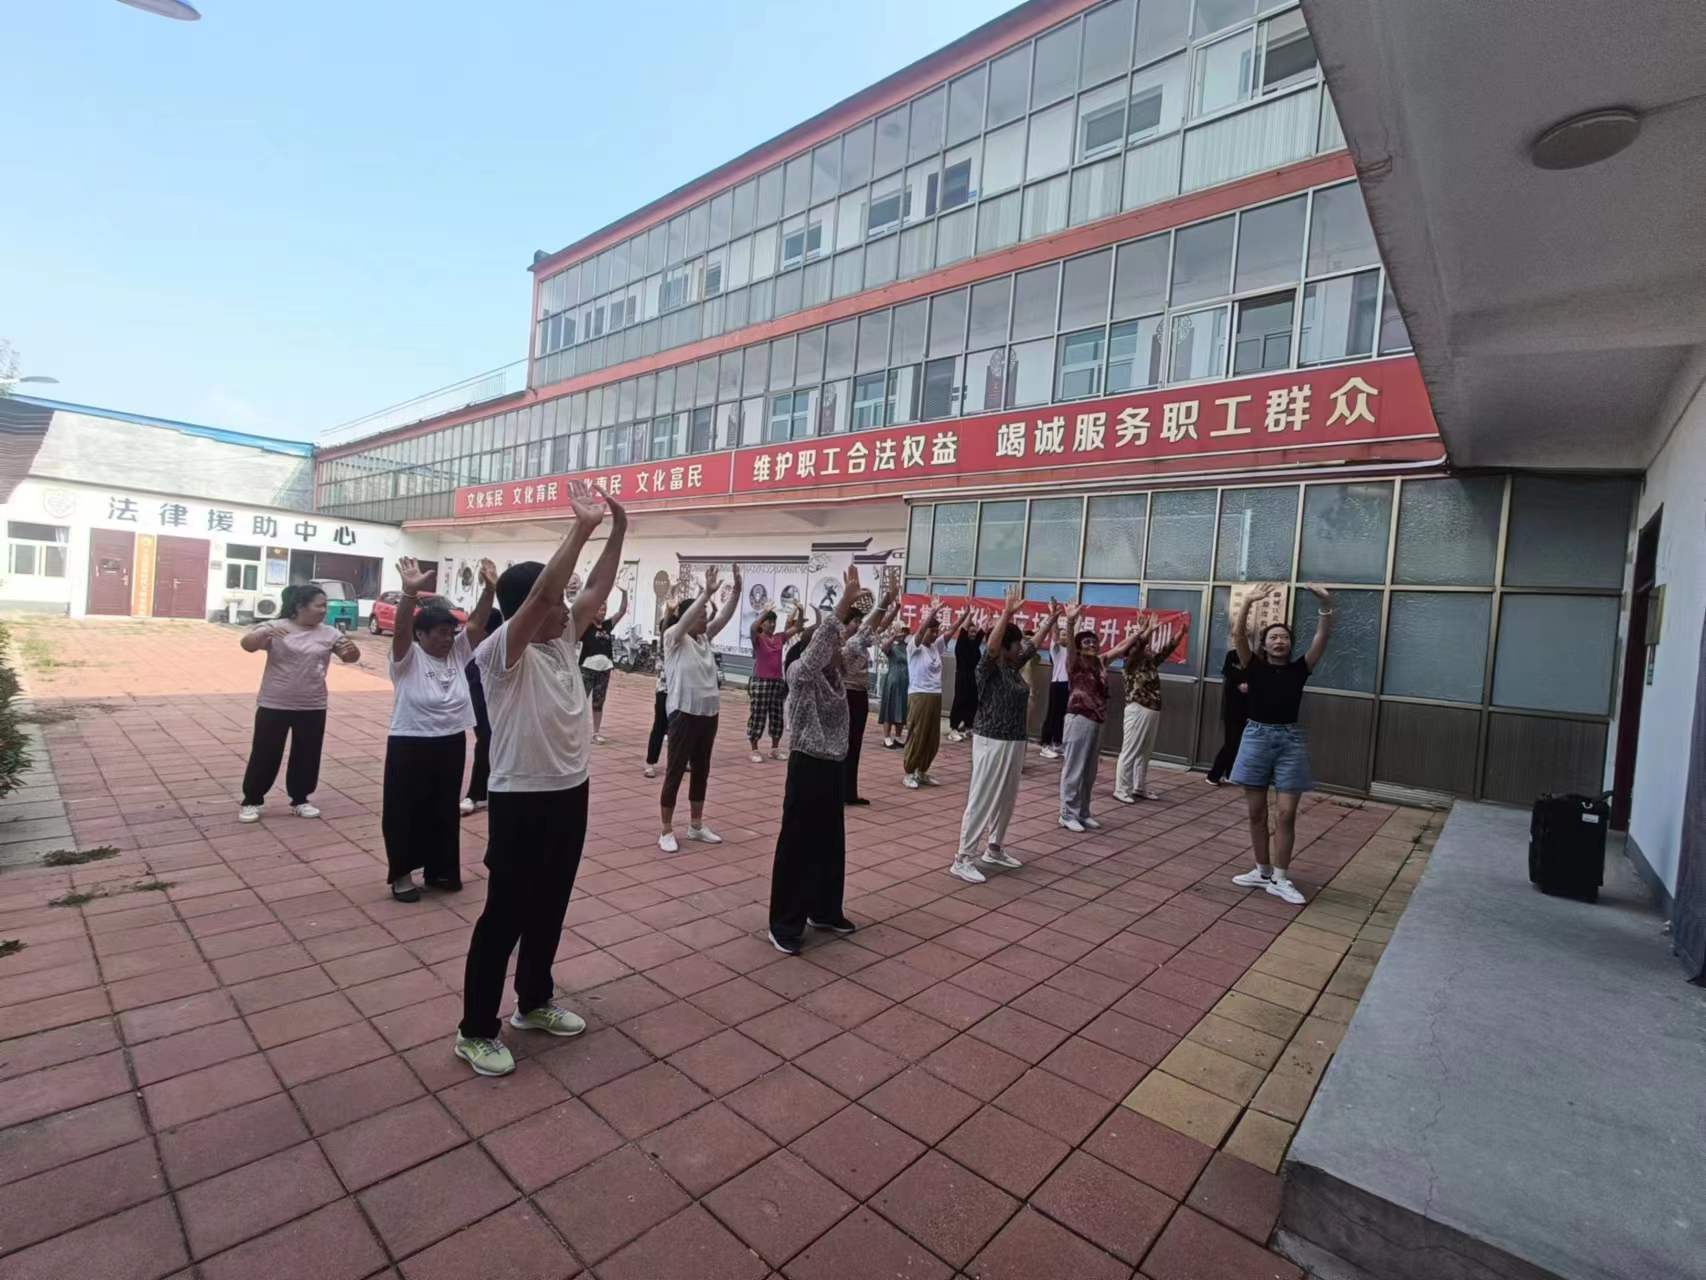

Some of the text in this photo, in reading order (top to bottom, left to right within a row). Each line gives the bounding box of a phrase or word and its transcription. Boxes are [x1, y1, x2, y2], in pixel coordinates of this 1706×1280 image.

[752, 377, 1377, 482] 维护职工合法权益 竭诚服务职工群众
[466, 464, 702, 509] 文化乐民 文化育民 化惠民 文化富民
[108, 495, 357, 546] 法律援助中心
